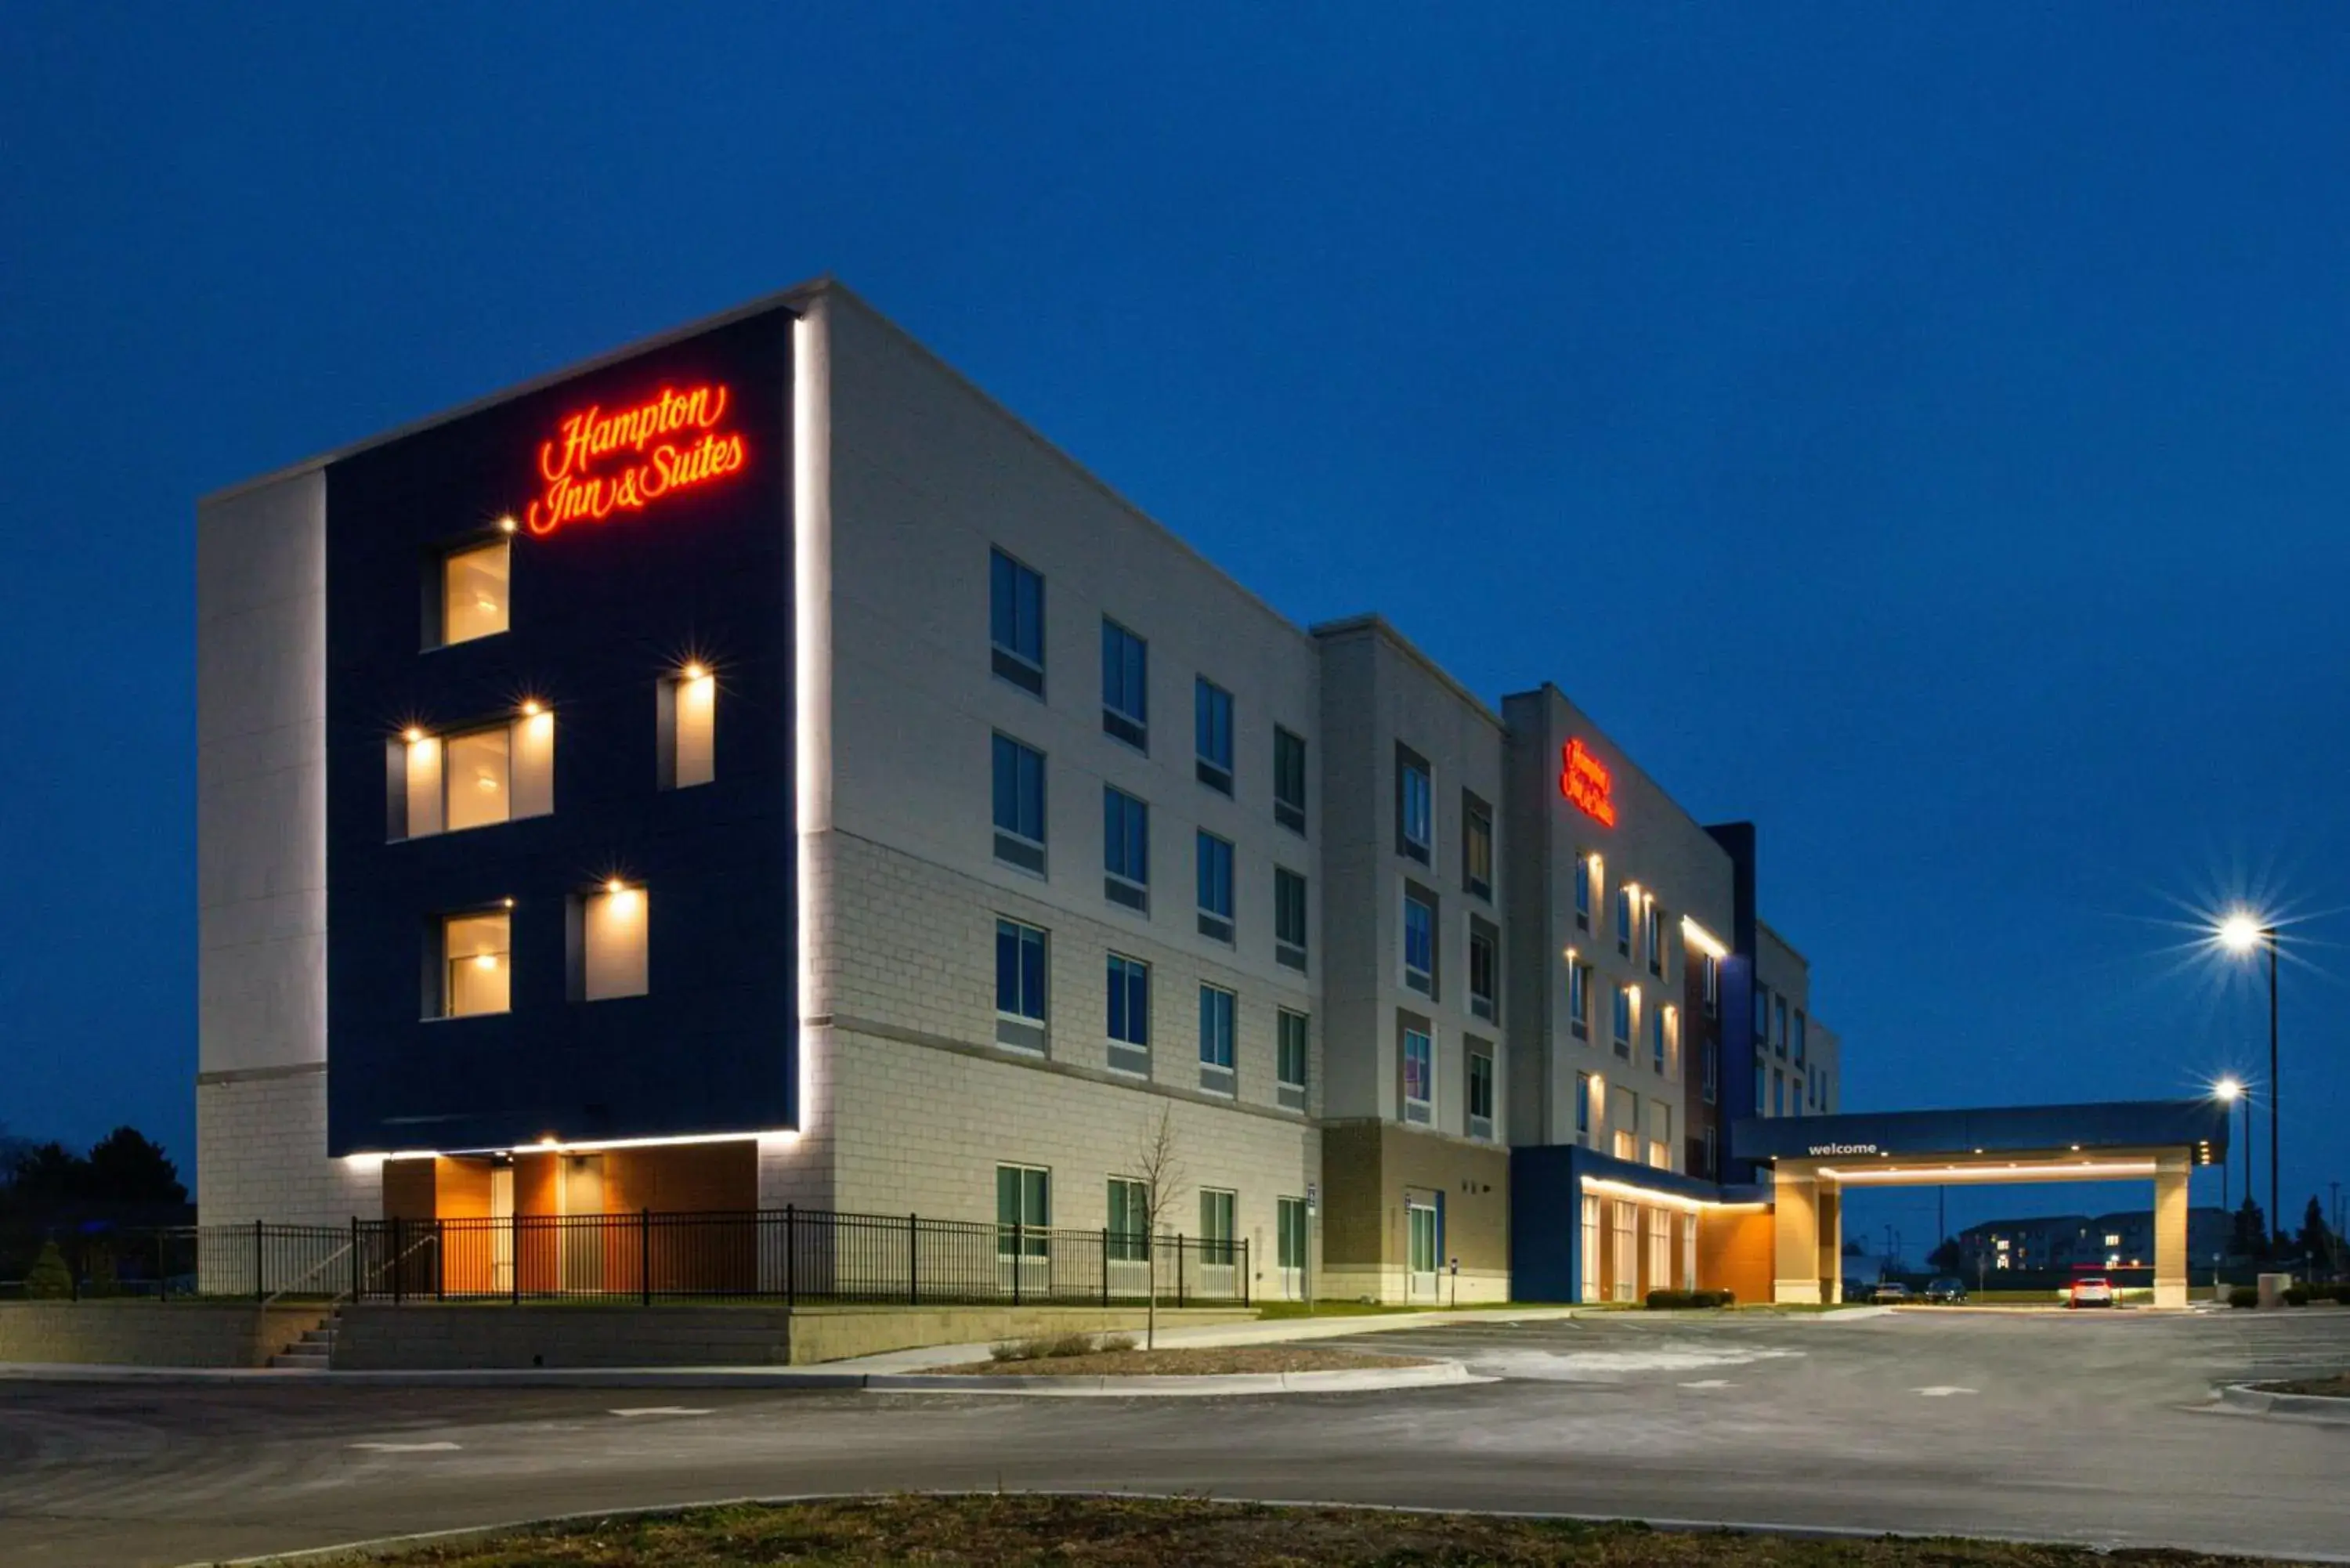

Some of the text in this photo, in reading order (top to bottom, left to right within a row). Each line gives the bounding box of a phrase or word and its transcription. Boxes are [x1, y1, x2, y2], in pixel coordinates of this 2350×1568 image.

[542, 385, 727, 482] Hampton
[529, 434, 743, 535] Inn & Suites
[1808, 1142, 1878, 1155] welcome
